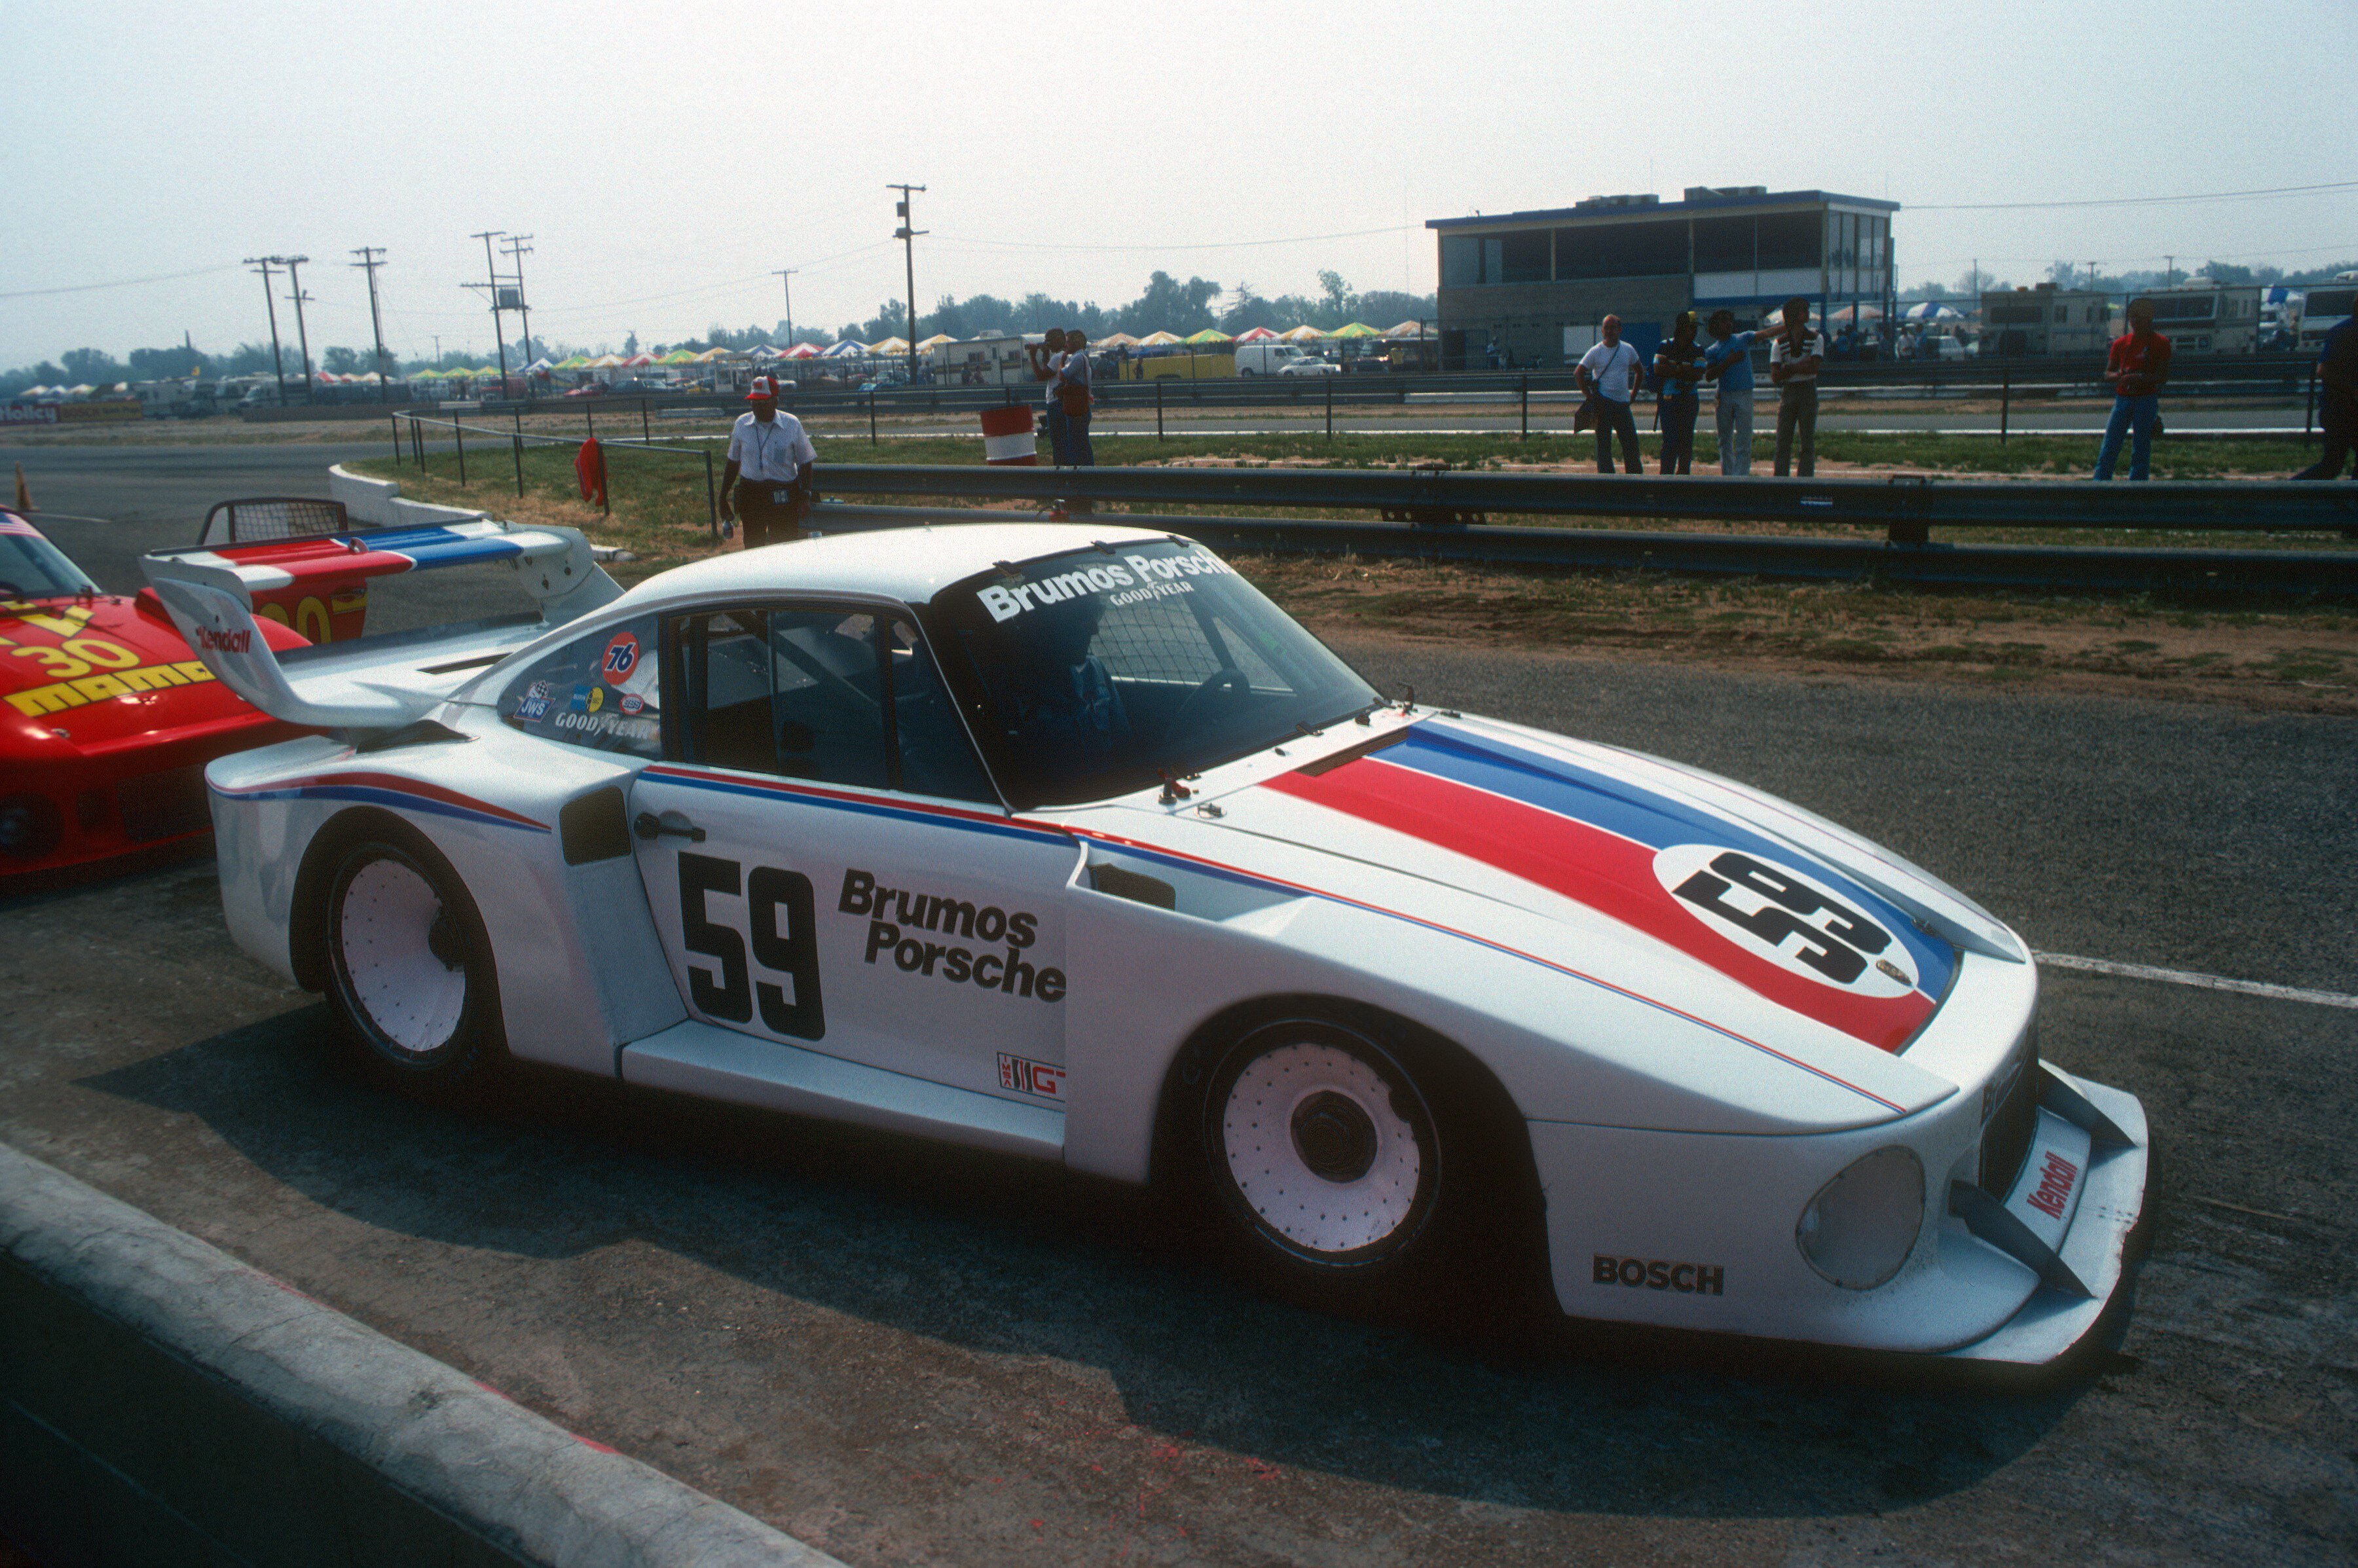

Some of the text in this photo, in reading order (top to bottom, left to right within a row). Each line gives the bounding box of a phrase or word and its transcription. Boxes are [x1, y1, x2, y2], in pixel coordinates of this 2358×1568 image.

[976, 564, 1134, 623] Brumos
[1109, 581, 1194, 606] GOODYEAR
[10, 639, 140, 678] 30
[196, 626, 251, 653] Kendall
[604, 642, 636, 673] 76
[521, 701, 545, 716] JWS
[555, 712, 649, 739] GOODYEAR
[838, 869, 1038, 948] Brumos
[1671, 852, 1892, 984] 59
[678, 852, 825, 1042] 59
[864, 921, 1066, 1003] Porsche
[1002, 1055, 1012, 1087] IMSA
[2027, 1150, 2078, 1220] Kendall
[1593, 1253, 1724, 1296] BOSCH
